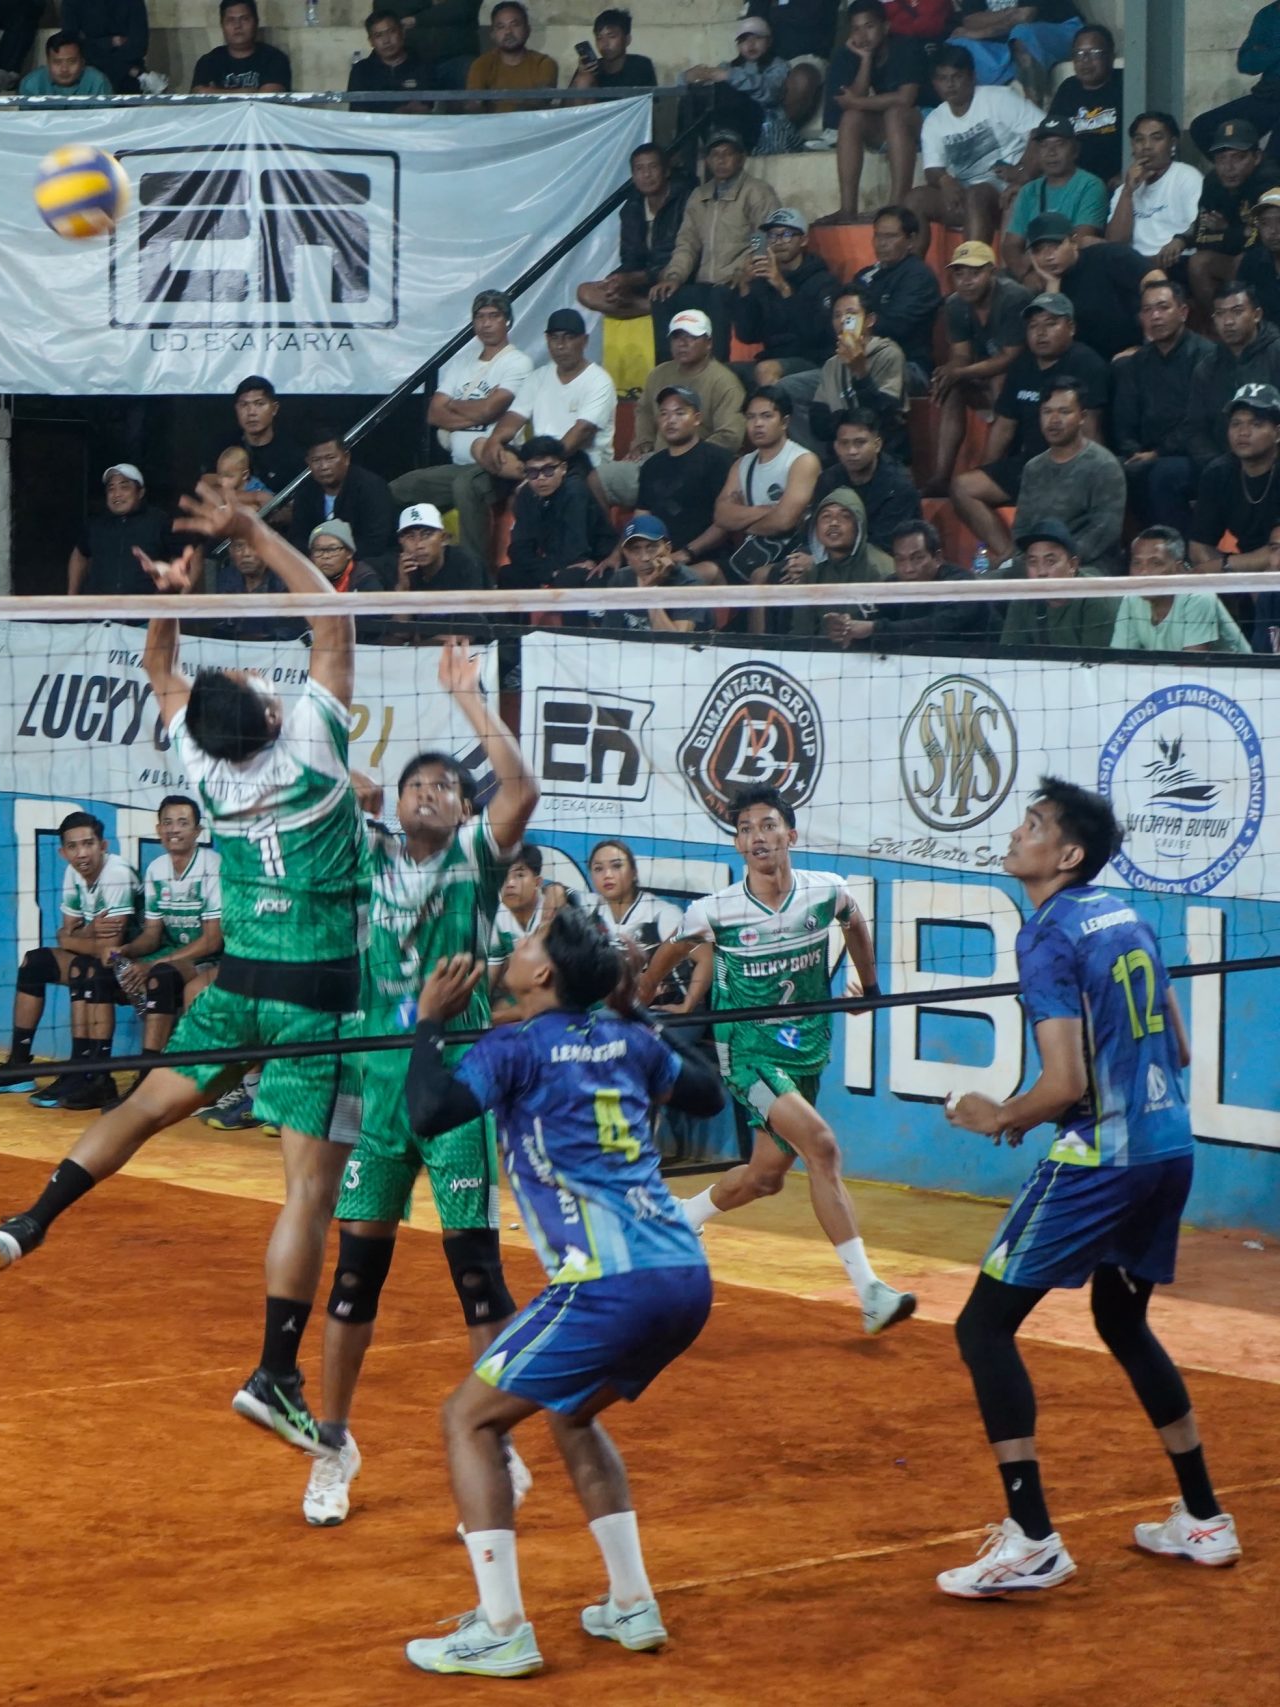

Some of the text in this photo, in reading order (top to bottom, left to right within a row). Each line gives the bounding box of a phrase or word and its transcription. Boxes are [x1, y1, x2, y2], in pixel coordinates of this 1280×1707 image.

[204, 333, 254, 351] EKA
[266, 333, 355, 351] KARYA
[272, 668, 310, 685] OPEN
[17, 674, 154, 746] LUCKY
[693, 674, 817, 758] BIMANTARA GROUP
[1099, 757, 1116, 796] USA
[1108, 700, 1158, 755] PENIDA
[1166, 688, 1253, 742] LEMBONGAN
[1126, 813, 1182, 834] WIJAYA
[743, 948, 822, 977] LUCKY BOYS
[1112, 949, 1164, 1039] 12
[345, 1159, 361, 1190] 3
